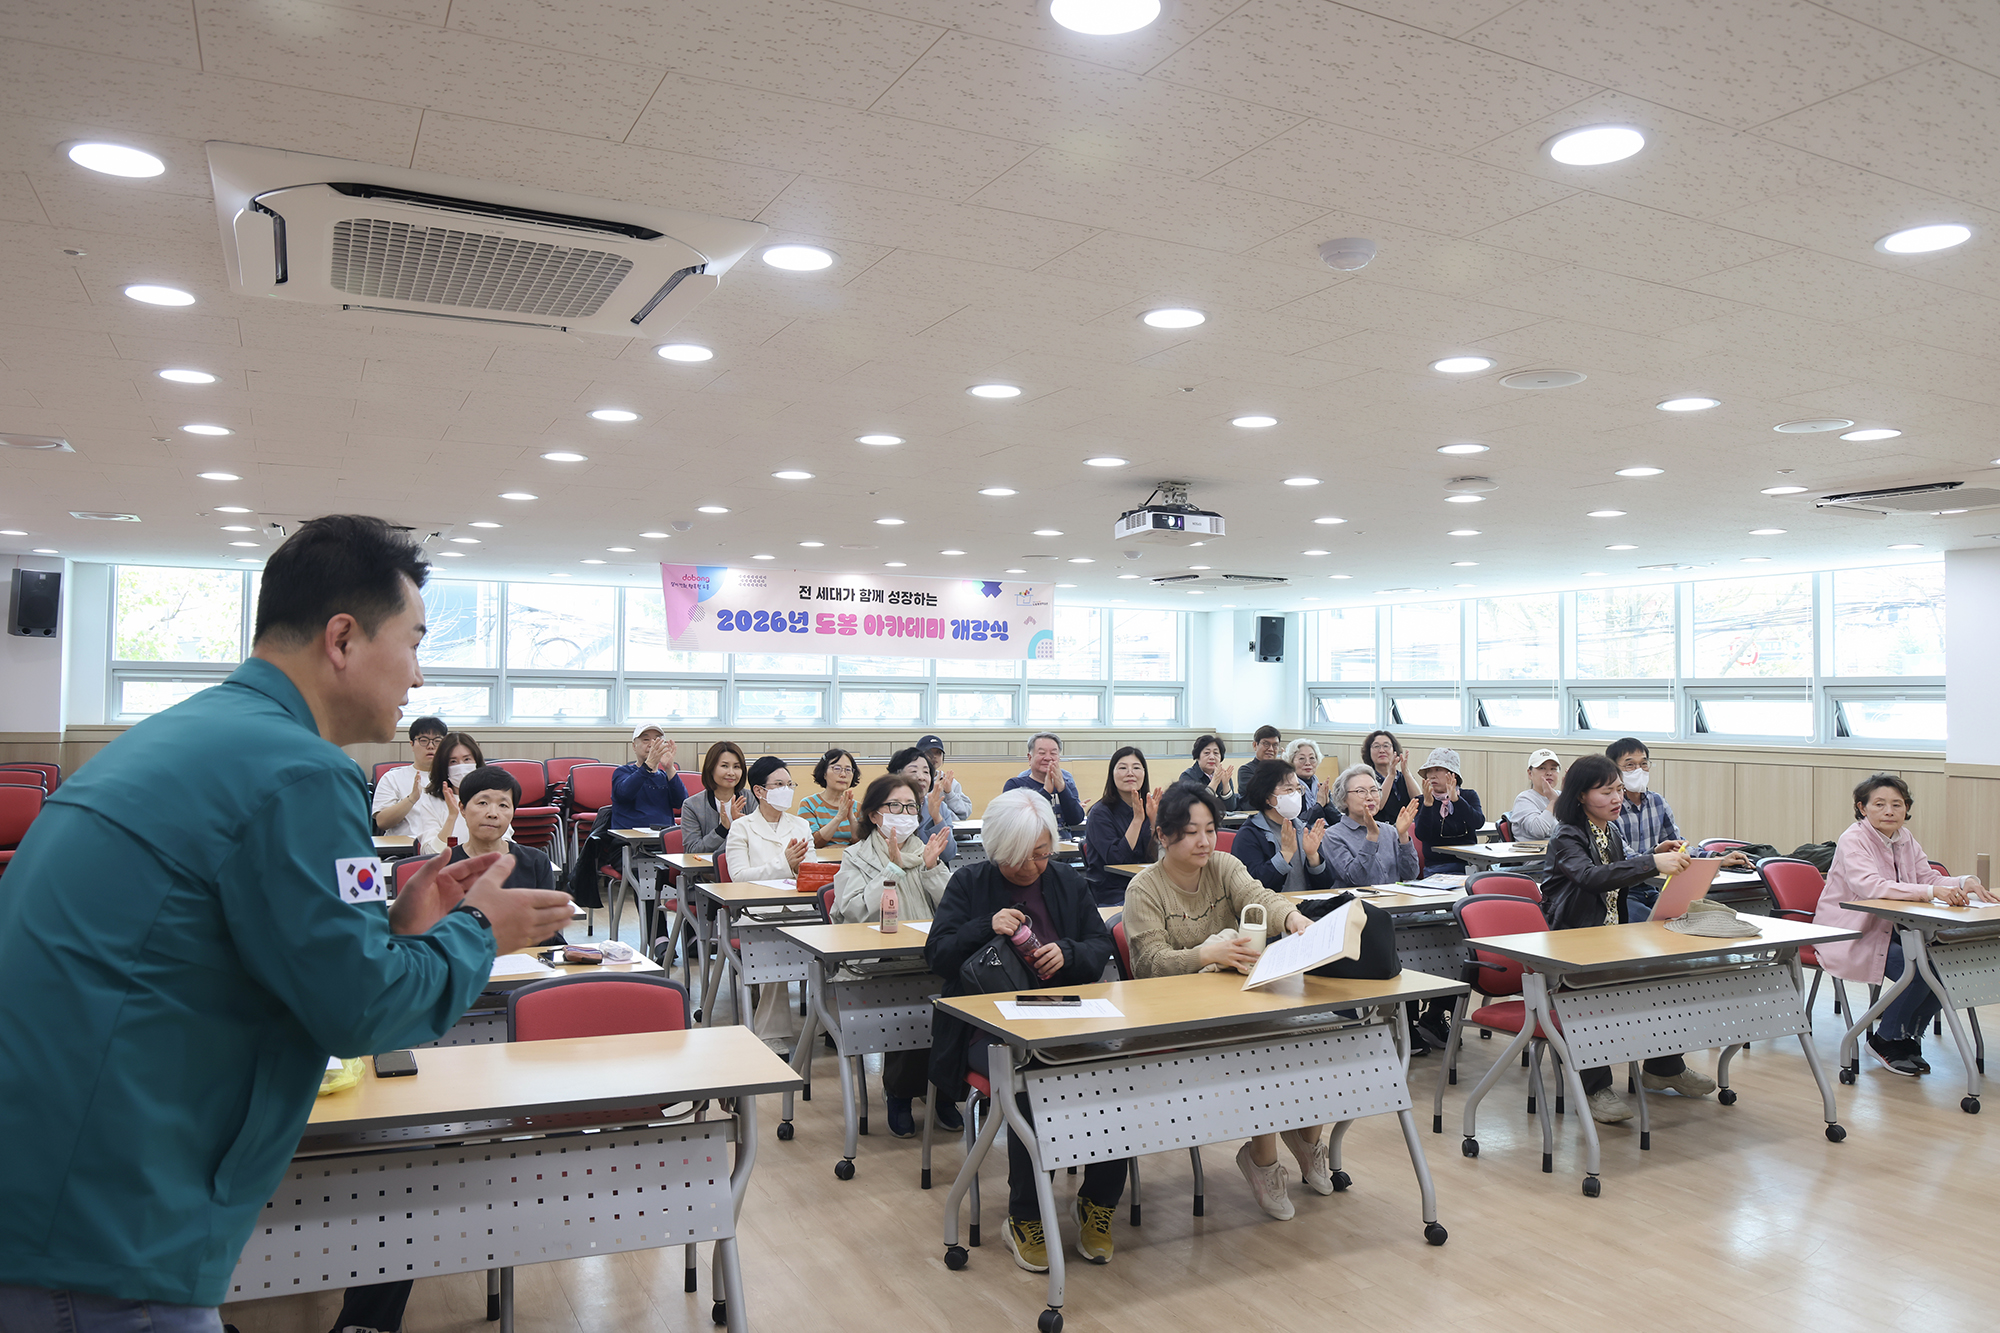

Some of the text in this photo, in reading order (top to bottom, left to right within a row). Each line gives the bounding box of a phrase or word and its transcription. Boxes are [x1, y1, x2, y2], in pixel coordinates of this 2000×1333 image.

[682, 573, 710, 584] dobong
[799, 585, 938, 607] 전 세대가 함께 성장하는
[717, 609, 1009, 641] 2026년 도봉 아카데미 개강식
